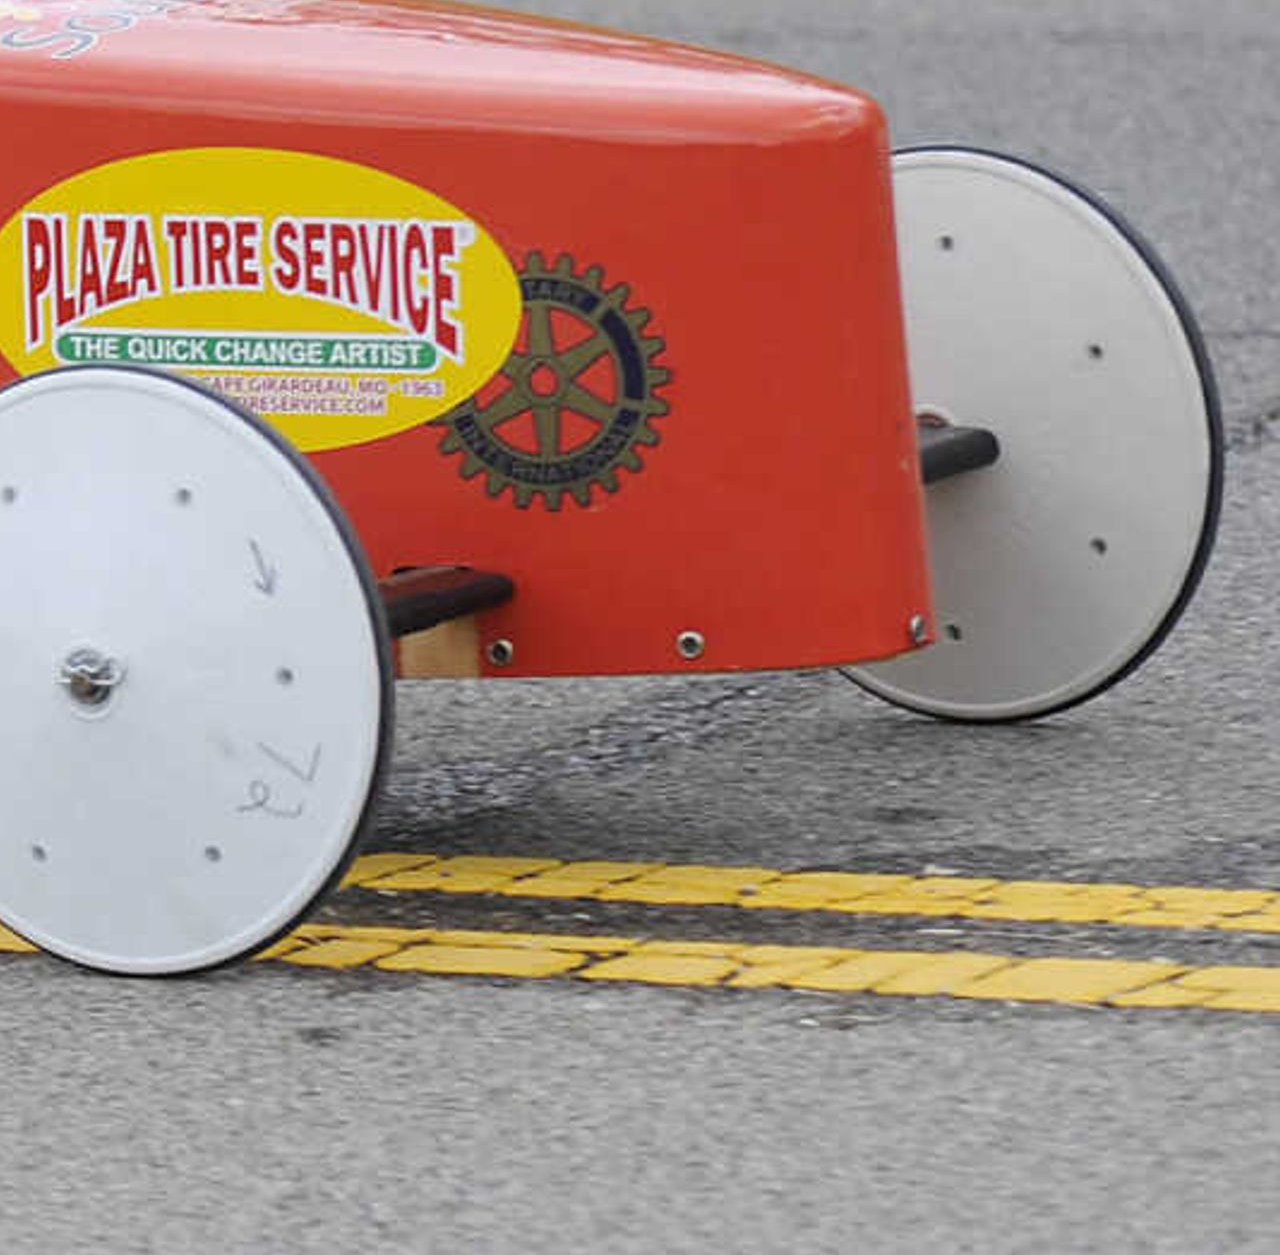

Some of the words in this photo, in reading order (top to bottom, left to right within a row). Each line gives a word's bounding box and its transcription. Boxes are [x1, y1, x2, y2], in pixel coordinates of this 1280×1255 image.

[25, 215, 160, 348] PLAZA
[165, 218, 262, 290] TIRE
[272, 220, 460, 357] SERVICE
[70, 336, 121, 359] THE
[127, 337, 208, 363] QUICK
[214, 340, 323, 365] CHANGE
[328, 343, 423, 367] ARTIST
